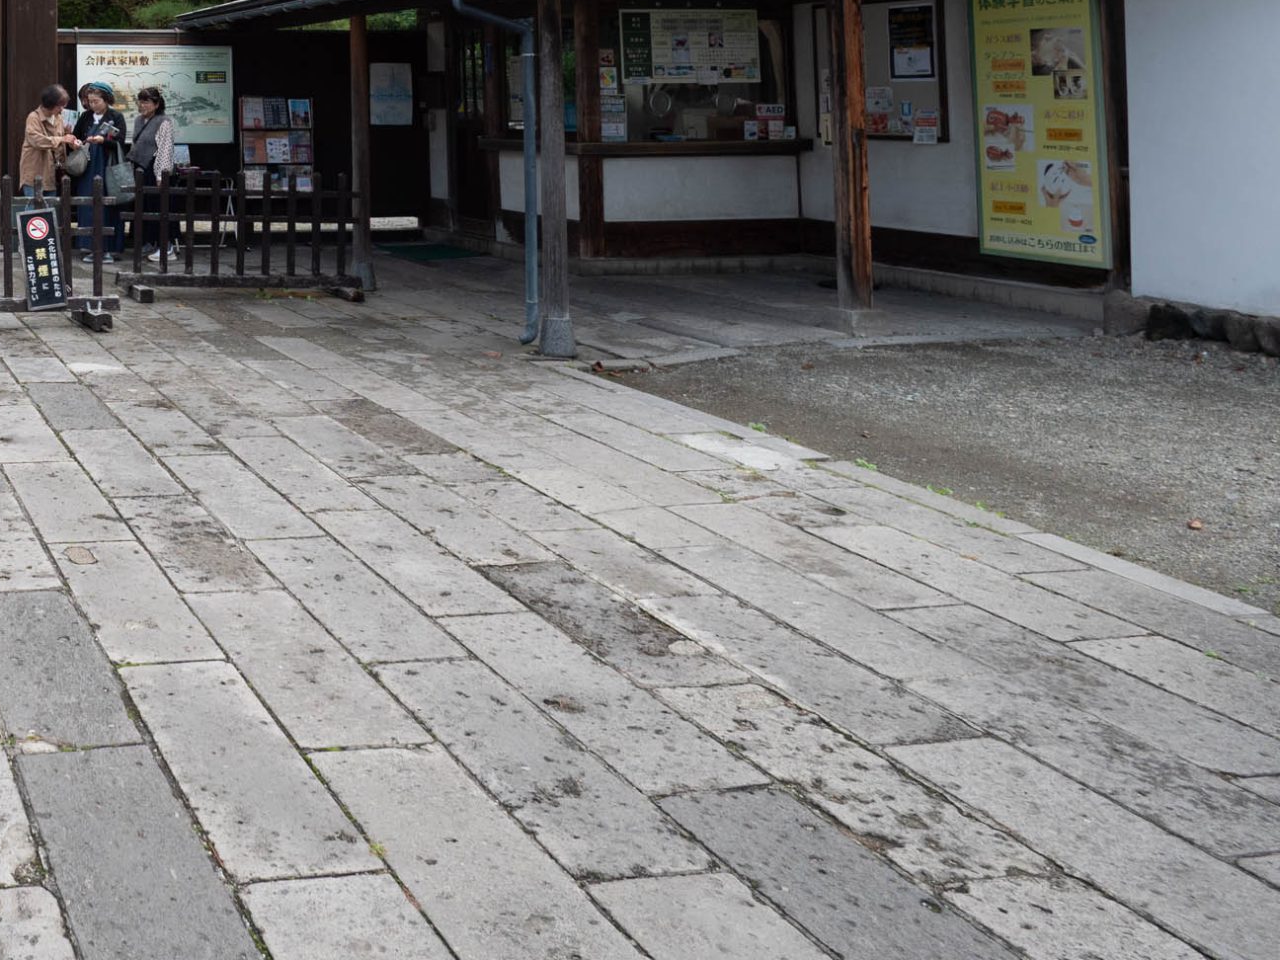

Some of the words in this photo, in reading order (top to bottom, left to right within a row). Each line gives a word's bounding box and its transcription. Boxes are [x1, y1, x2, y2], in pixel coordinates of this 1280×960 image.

[85, 55, 150, 66] 会津武家屋敷
[765, 106, 784, 114] AED
[27, 256, 39, 301] ご協力下さい
